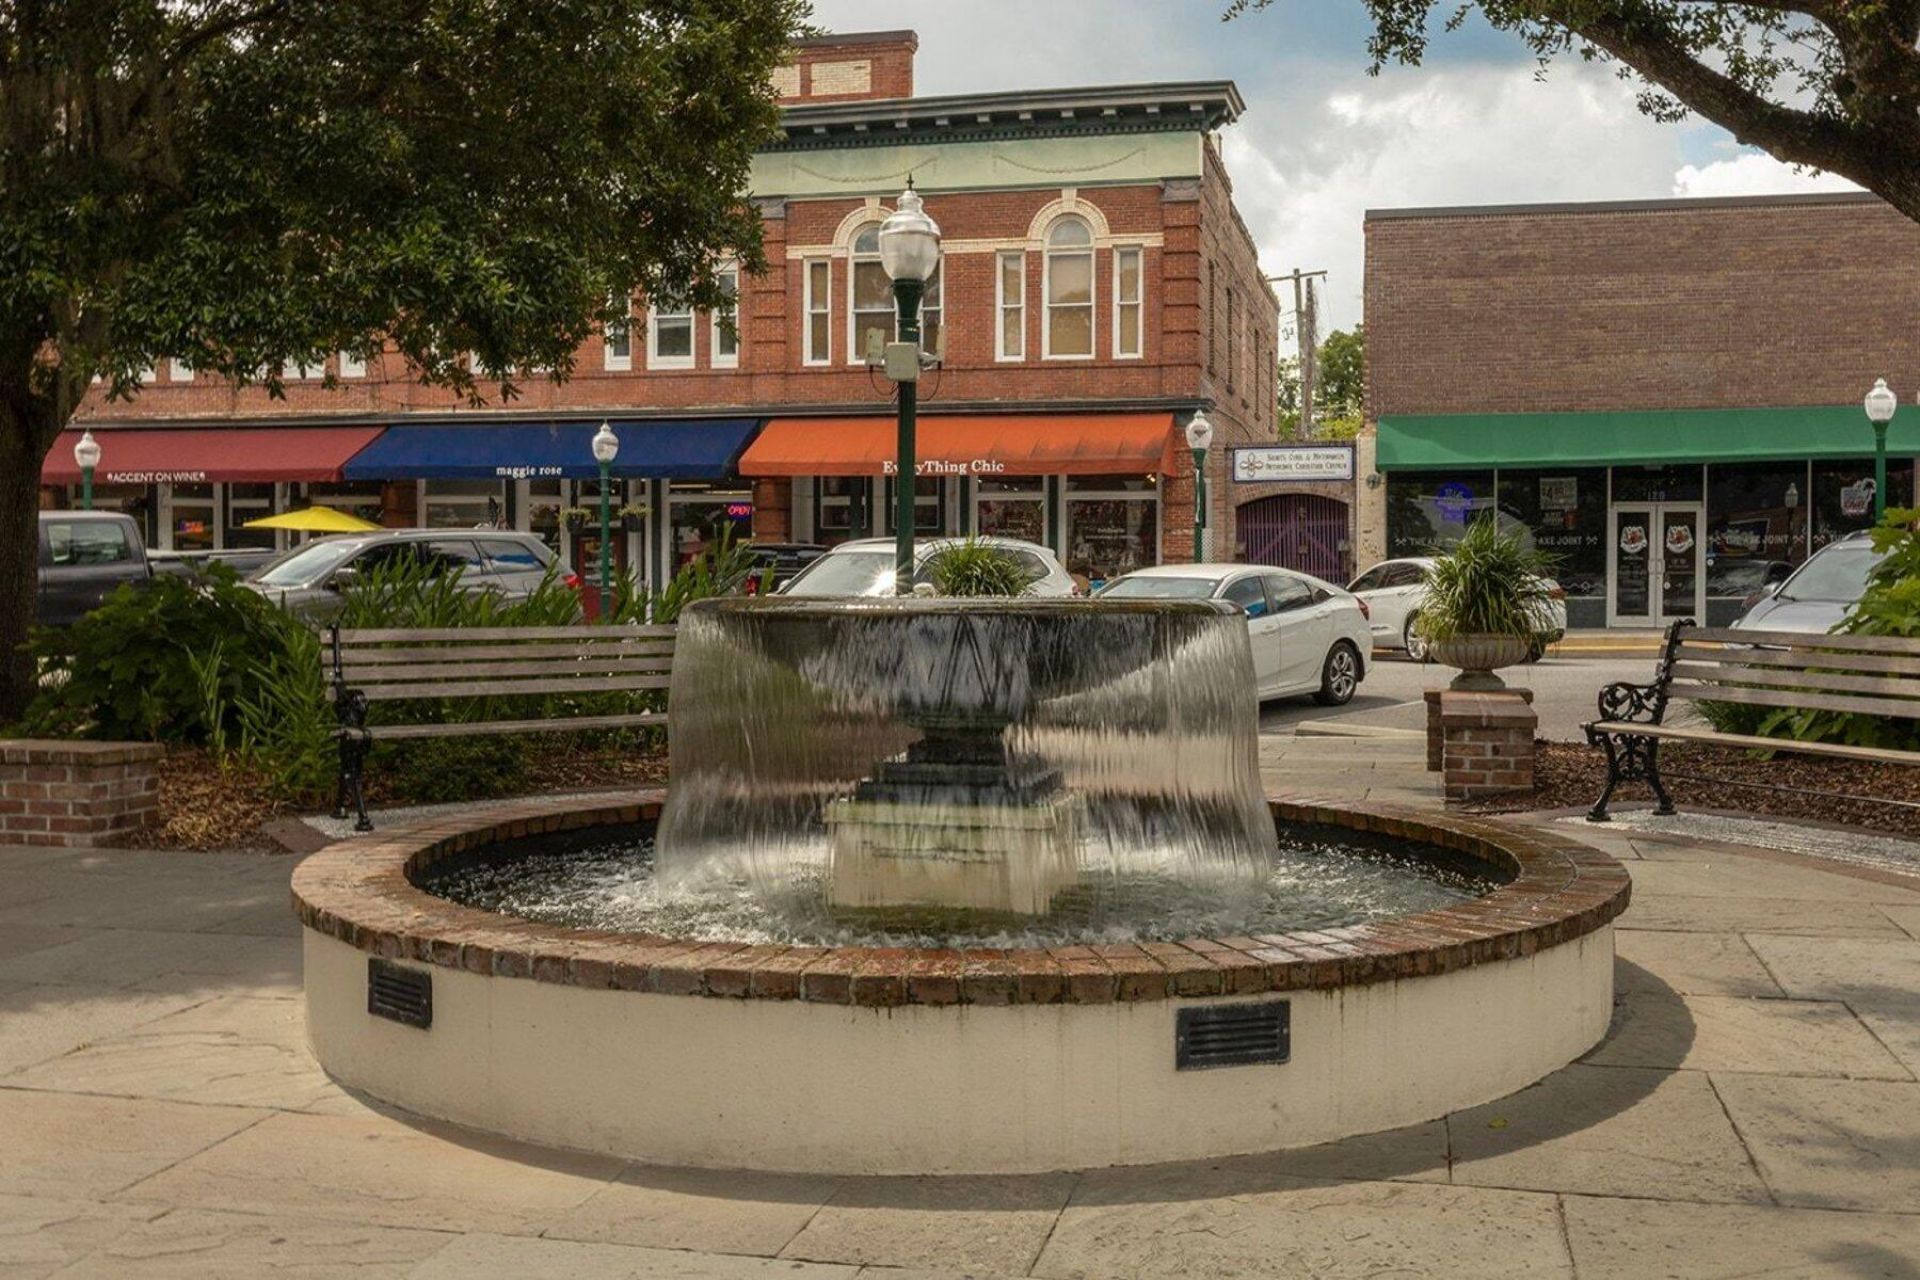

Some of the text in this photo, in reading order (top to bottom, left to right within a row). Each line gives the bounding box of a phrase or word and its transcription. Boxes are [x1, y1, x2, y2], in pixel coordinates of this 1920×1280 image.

[971, 459, 1005, 472] Chic
[113, 471, 200, 482] ACCENT ON WINE
[496, 465, 562, 479] maggie rose
[728, 505, 751, 516] OPEN
[1538, 535, 1582, 546] AXE JOINT
